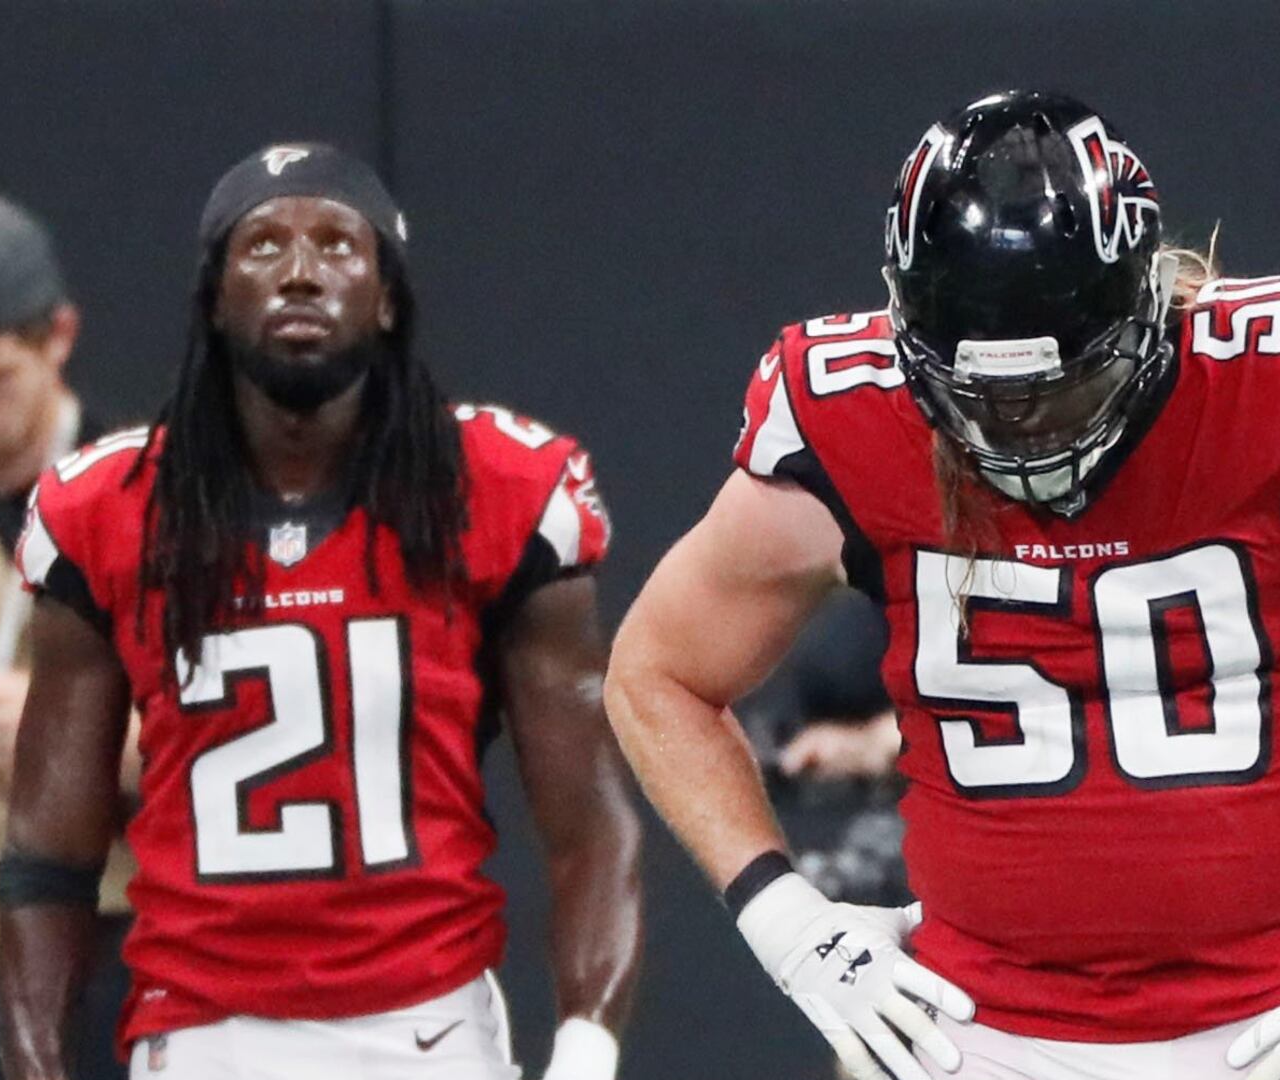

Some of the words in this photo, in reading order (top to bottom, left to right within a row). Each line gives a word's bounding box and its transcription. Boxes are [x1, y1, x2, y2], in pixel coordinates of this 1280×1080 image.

[914, 544, 1261, 787] 50
[1014, 541, 1129, 559] FALCONS
[175, 618, 408, 875] 21
